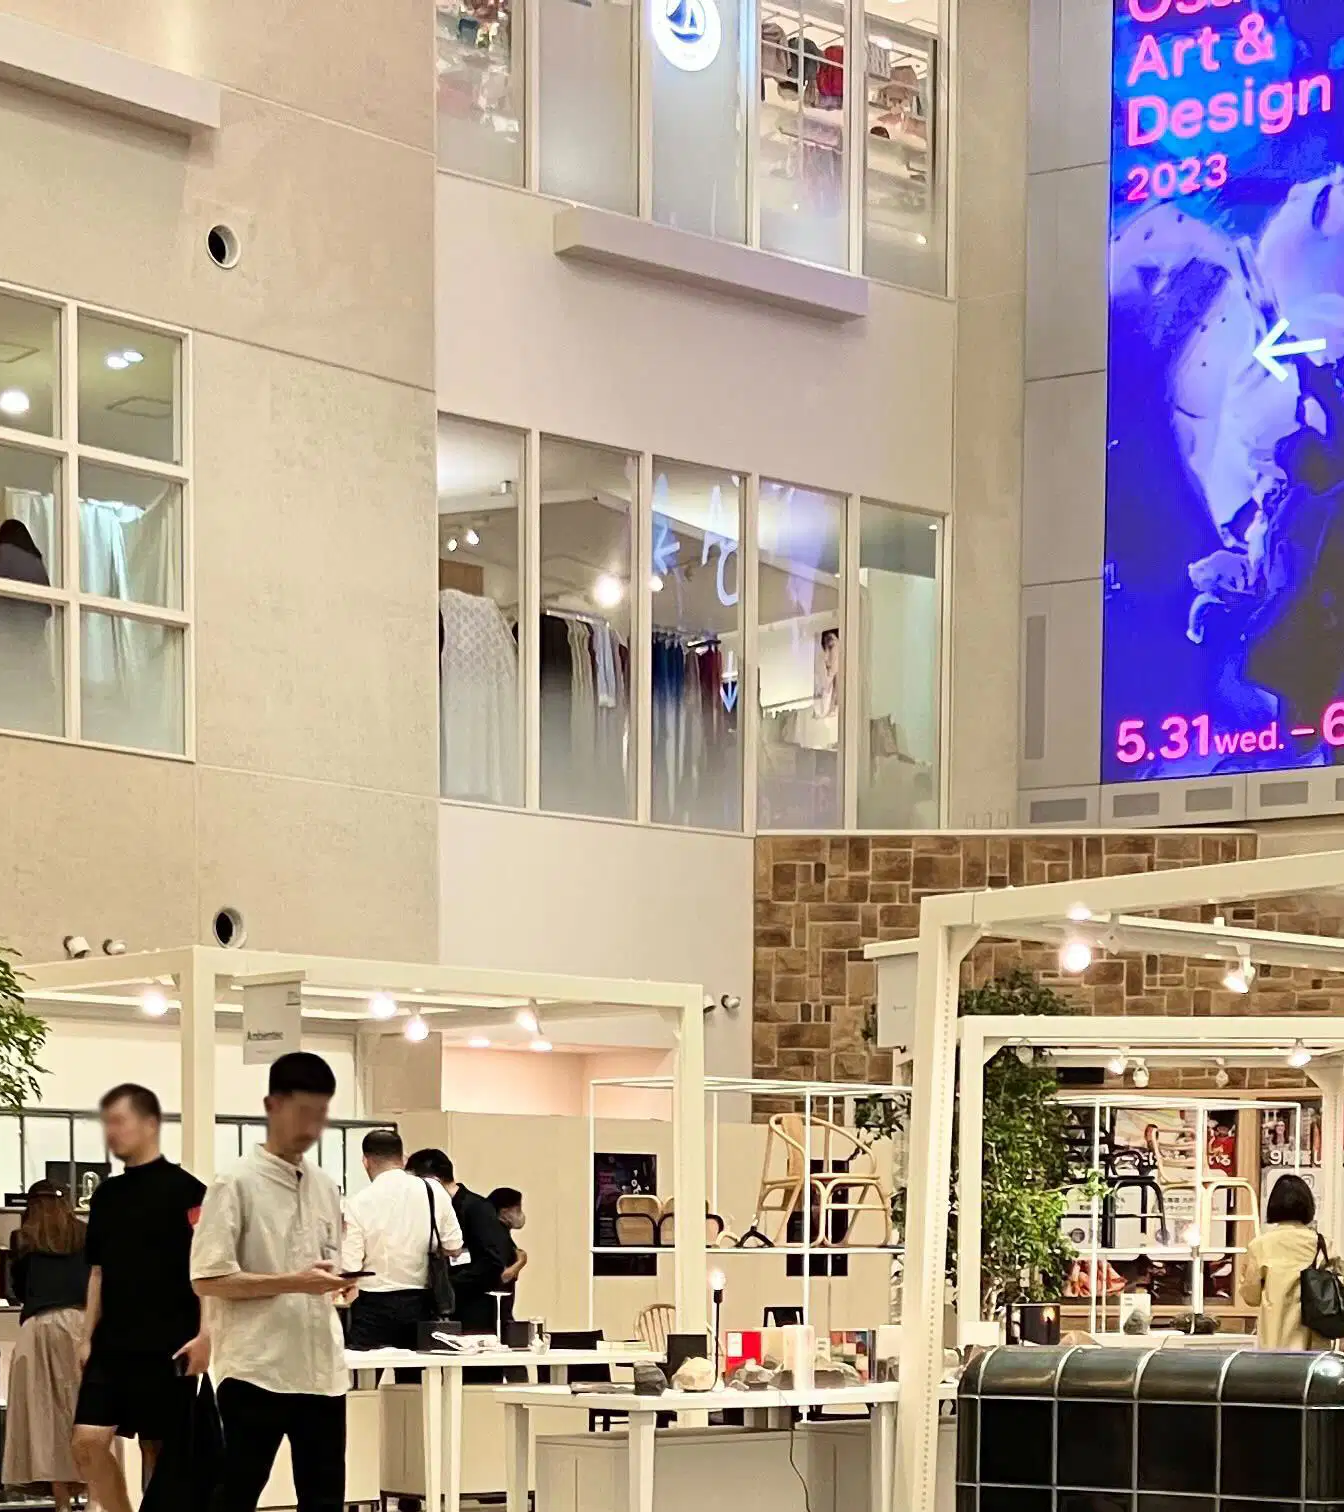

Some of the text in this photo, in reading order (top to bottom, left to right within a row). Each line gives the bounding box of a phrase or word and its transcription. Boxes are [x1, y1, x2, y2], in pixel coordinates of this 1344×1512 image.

[1126, 12, 1276, 87] Art &
[1126, 74, 1333, 147] Design
[1126, 153, 1229, 201] 2023
